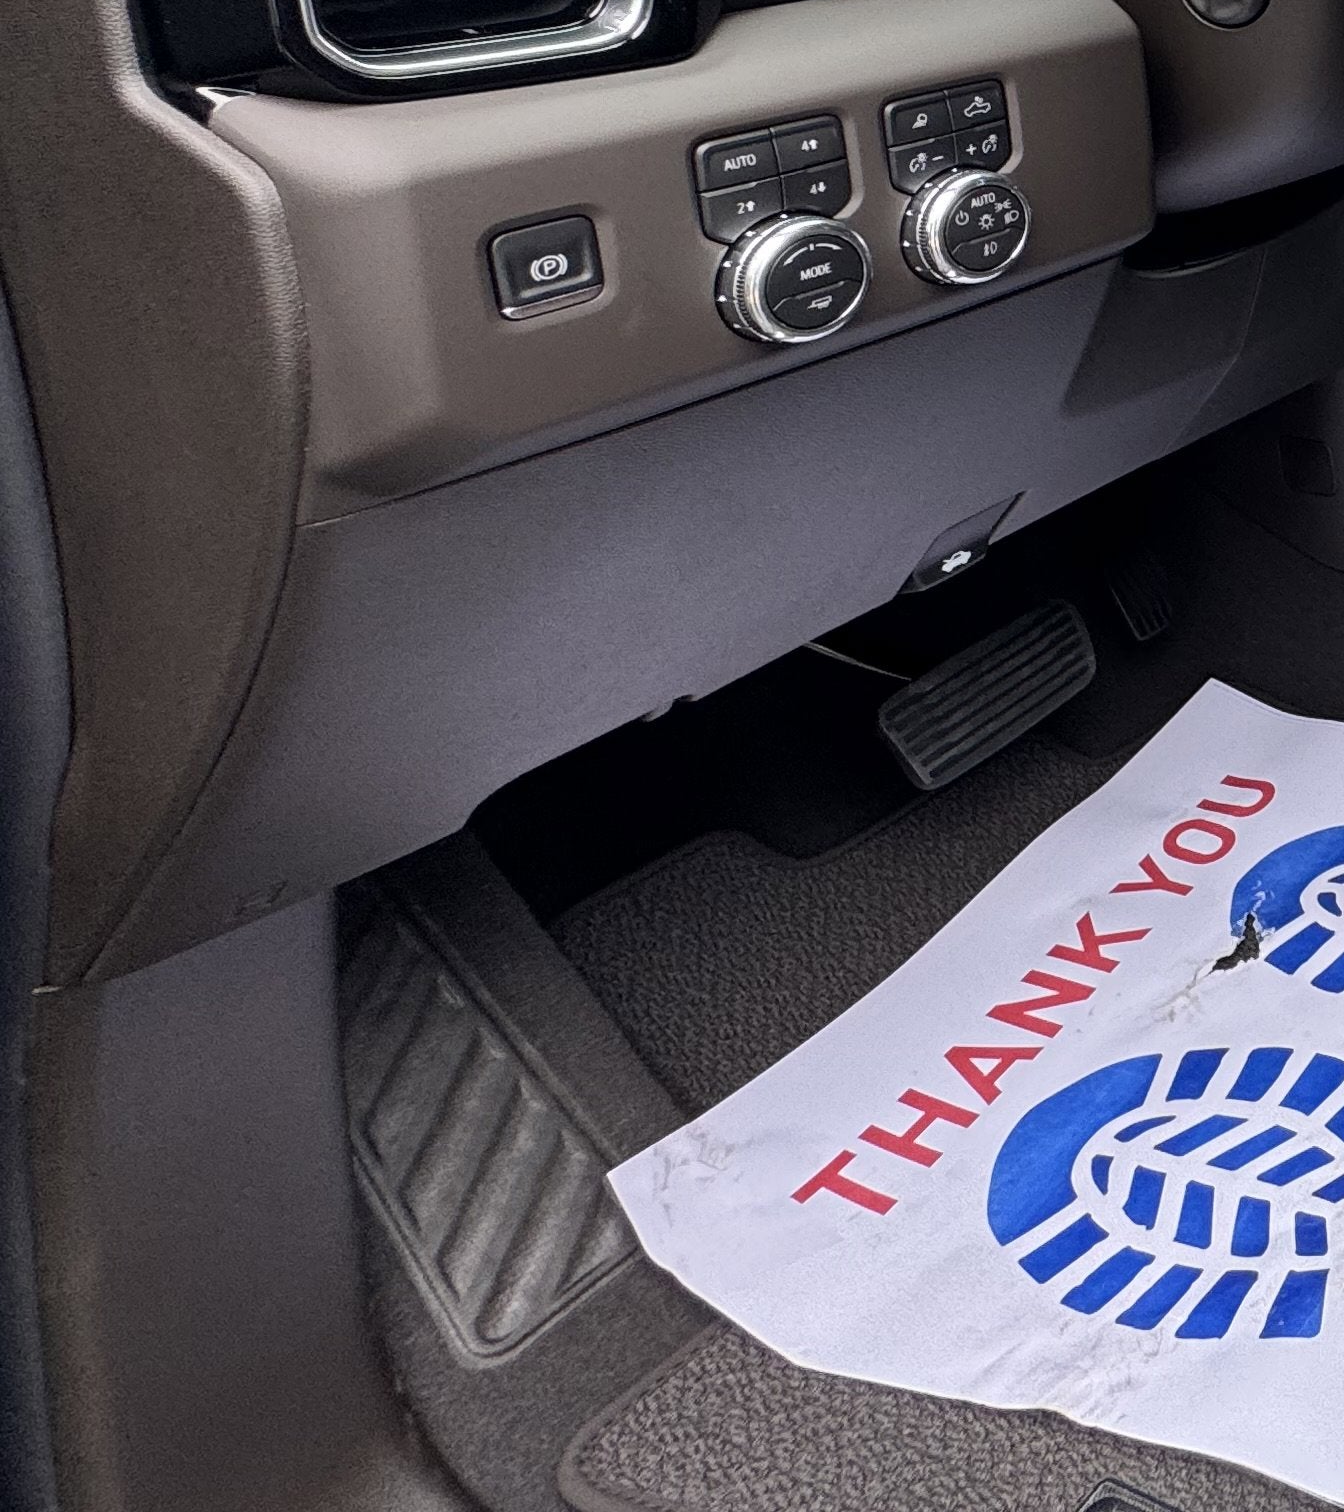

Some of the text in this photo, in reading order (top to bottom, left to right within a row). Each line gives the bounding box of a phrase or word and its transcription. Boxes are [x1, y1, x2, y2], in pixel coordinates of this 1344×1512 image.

[724, 153, 757, 171] AUTO
[971, 192, 996, 209] AUTO
[800, 262, 833, 281] MODE
[791, 774, 1277, 1216] THANK YOU
